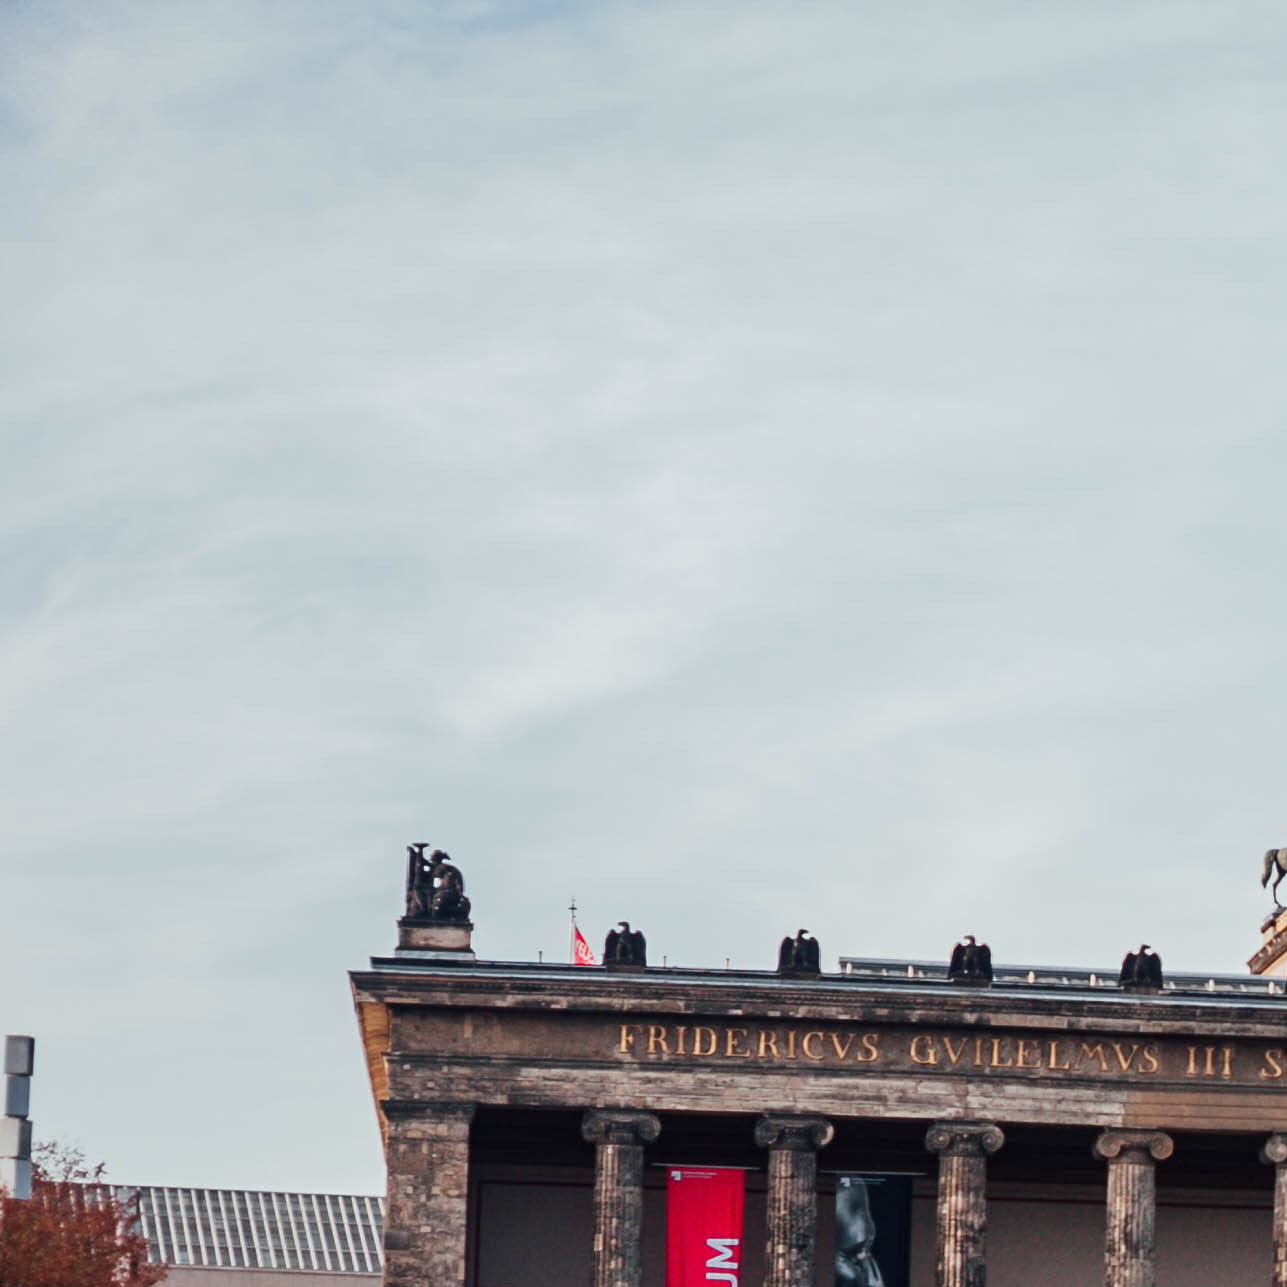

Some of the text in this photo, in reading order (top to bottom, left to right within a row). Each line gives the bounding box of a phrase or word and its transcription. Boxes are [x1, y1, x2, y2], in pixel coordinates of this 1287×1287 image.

[618, 1023, 879, 1063] FRIDERICVS
[910, 1034, 1160, 1074] GVILELMVS
[1186, 1046, 1234, 1076] III
